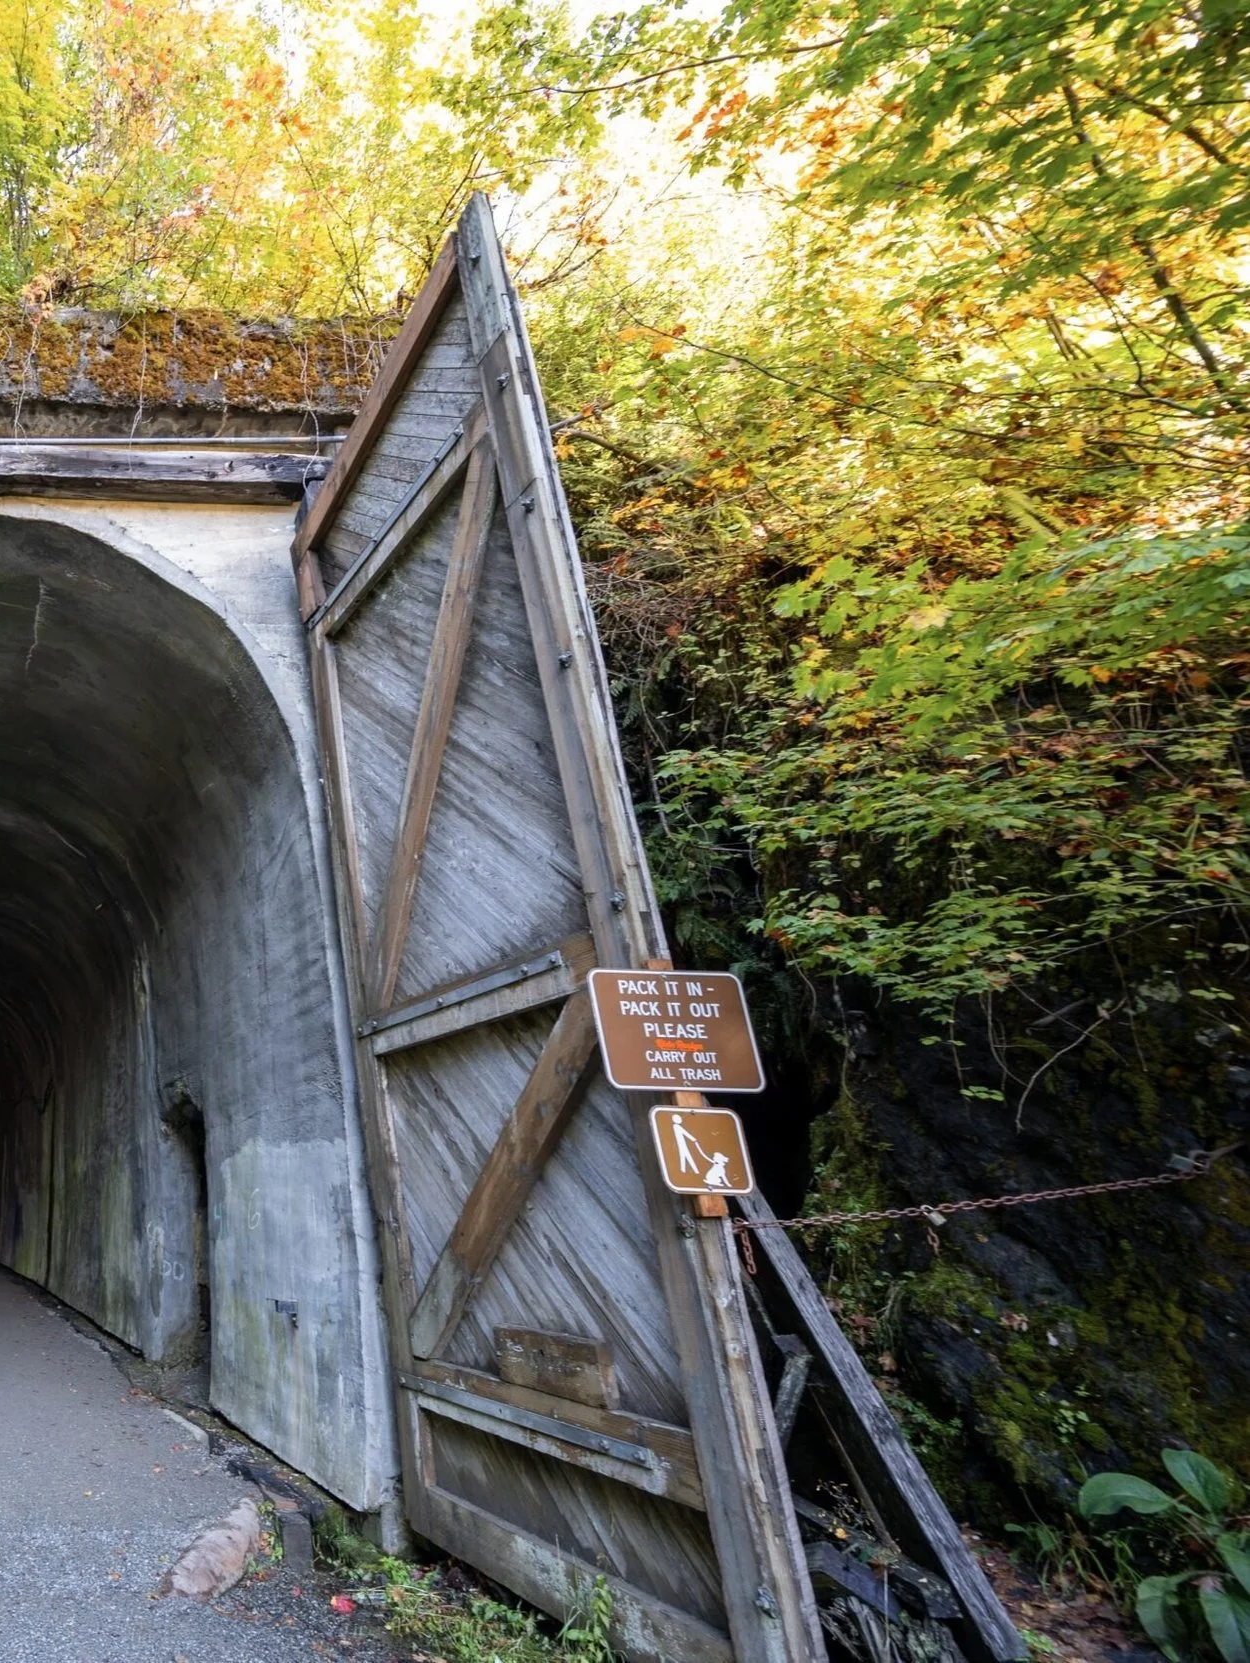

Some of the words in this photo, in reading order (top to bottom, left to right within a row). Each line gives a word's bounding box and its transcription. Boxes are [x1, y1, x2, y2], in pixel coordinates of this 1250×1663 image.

[617, 980, 659, 995] PACK
[664, 981, 678, 995] IT
[686, 982, 703, 996] IN
[619, 1001, 662, 1016] PACK
[667, 1002, 680, 1017] IT
[689, 1003, 720, 1018] OUT
[643, 1022, 708, 1038] PLEASE
[645, 1050, 686, 1063] CARRY
[693, 1052, 718, 1064] OUT
[650, 1067, 676, 1080] ALL
[679, 1068, 722, 1081] TRASH
